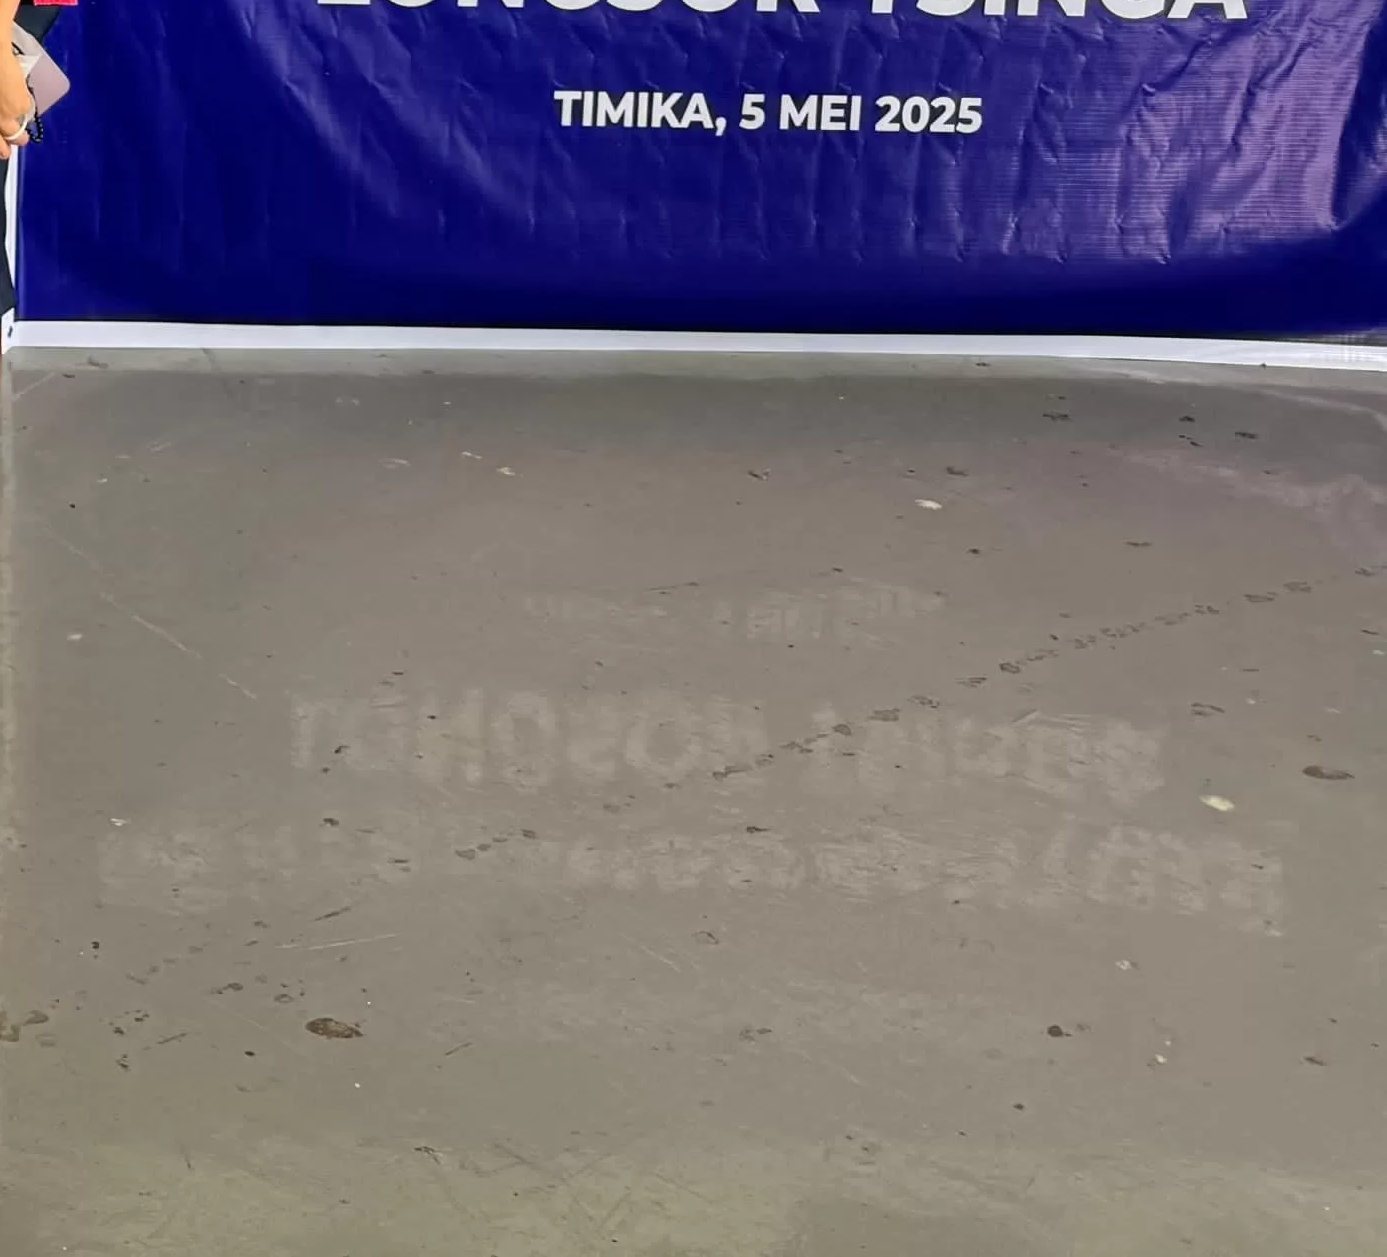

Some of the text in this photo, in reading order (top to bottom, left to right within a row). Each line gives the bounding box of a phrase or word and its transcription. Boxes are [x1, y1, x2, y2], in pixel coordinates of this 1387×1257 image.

[554, 91, 981, 135] TIMIKA, 5 MEI 2025
